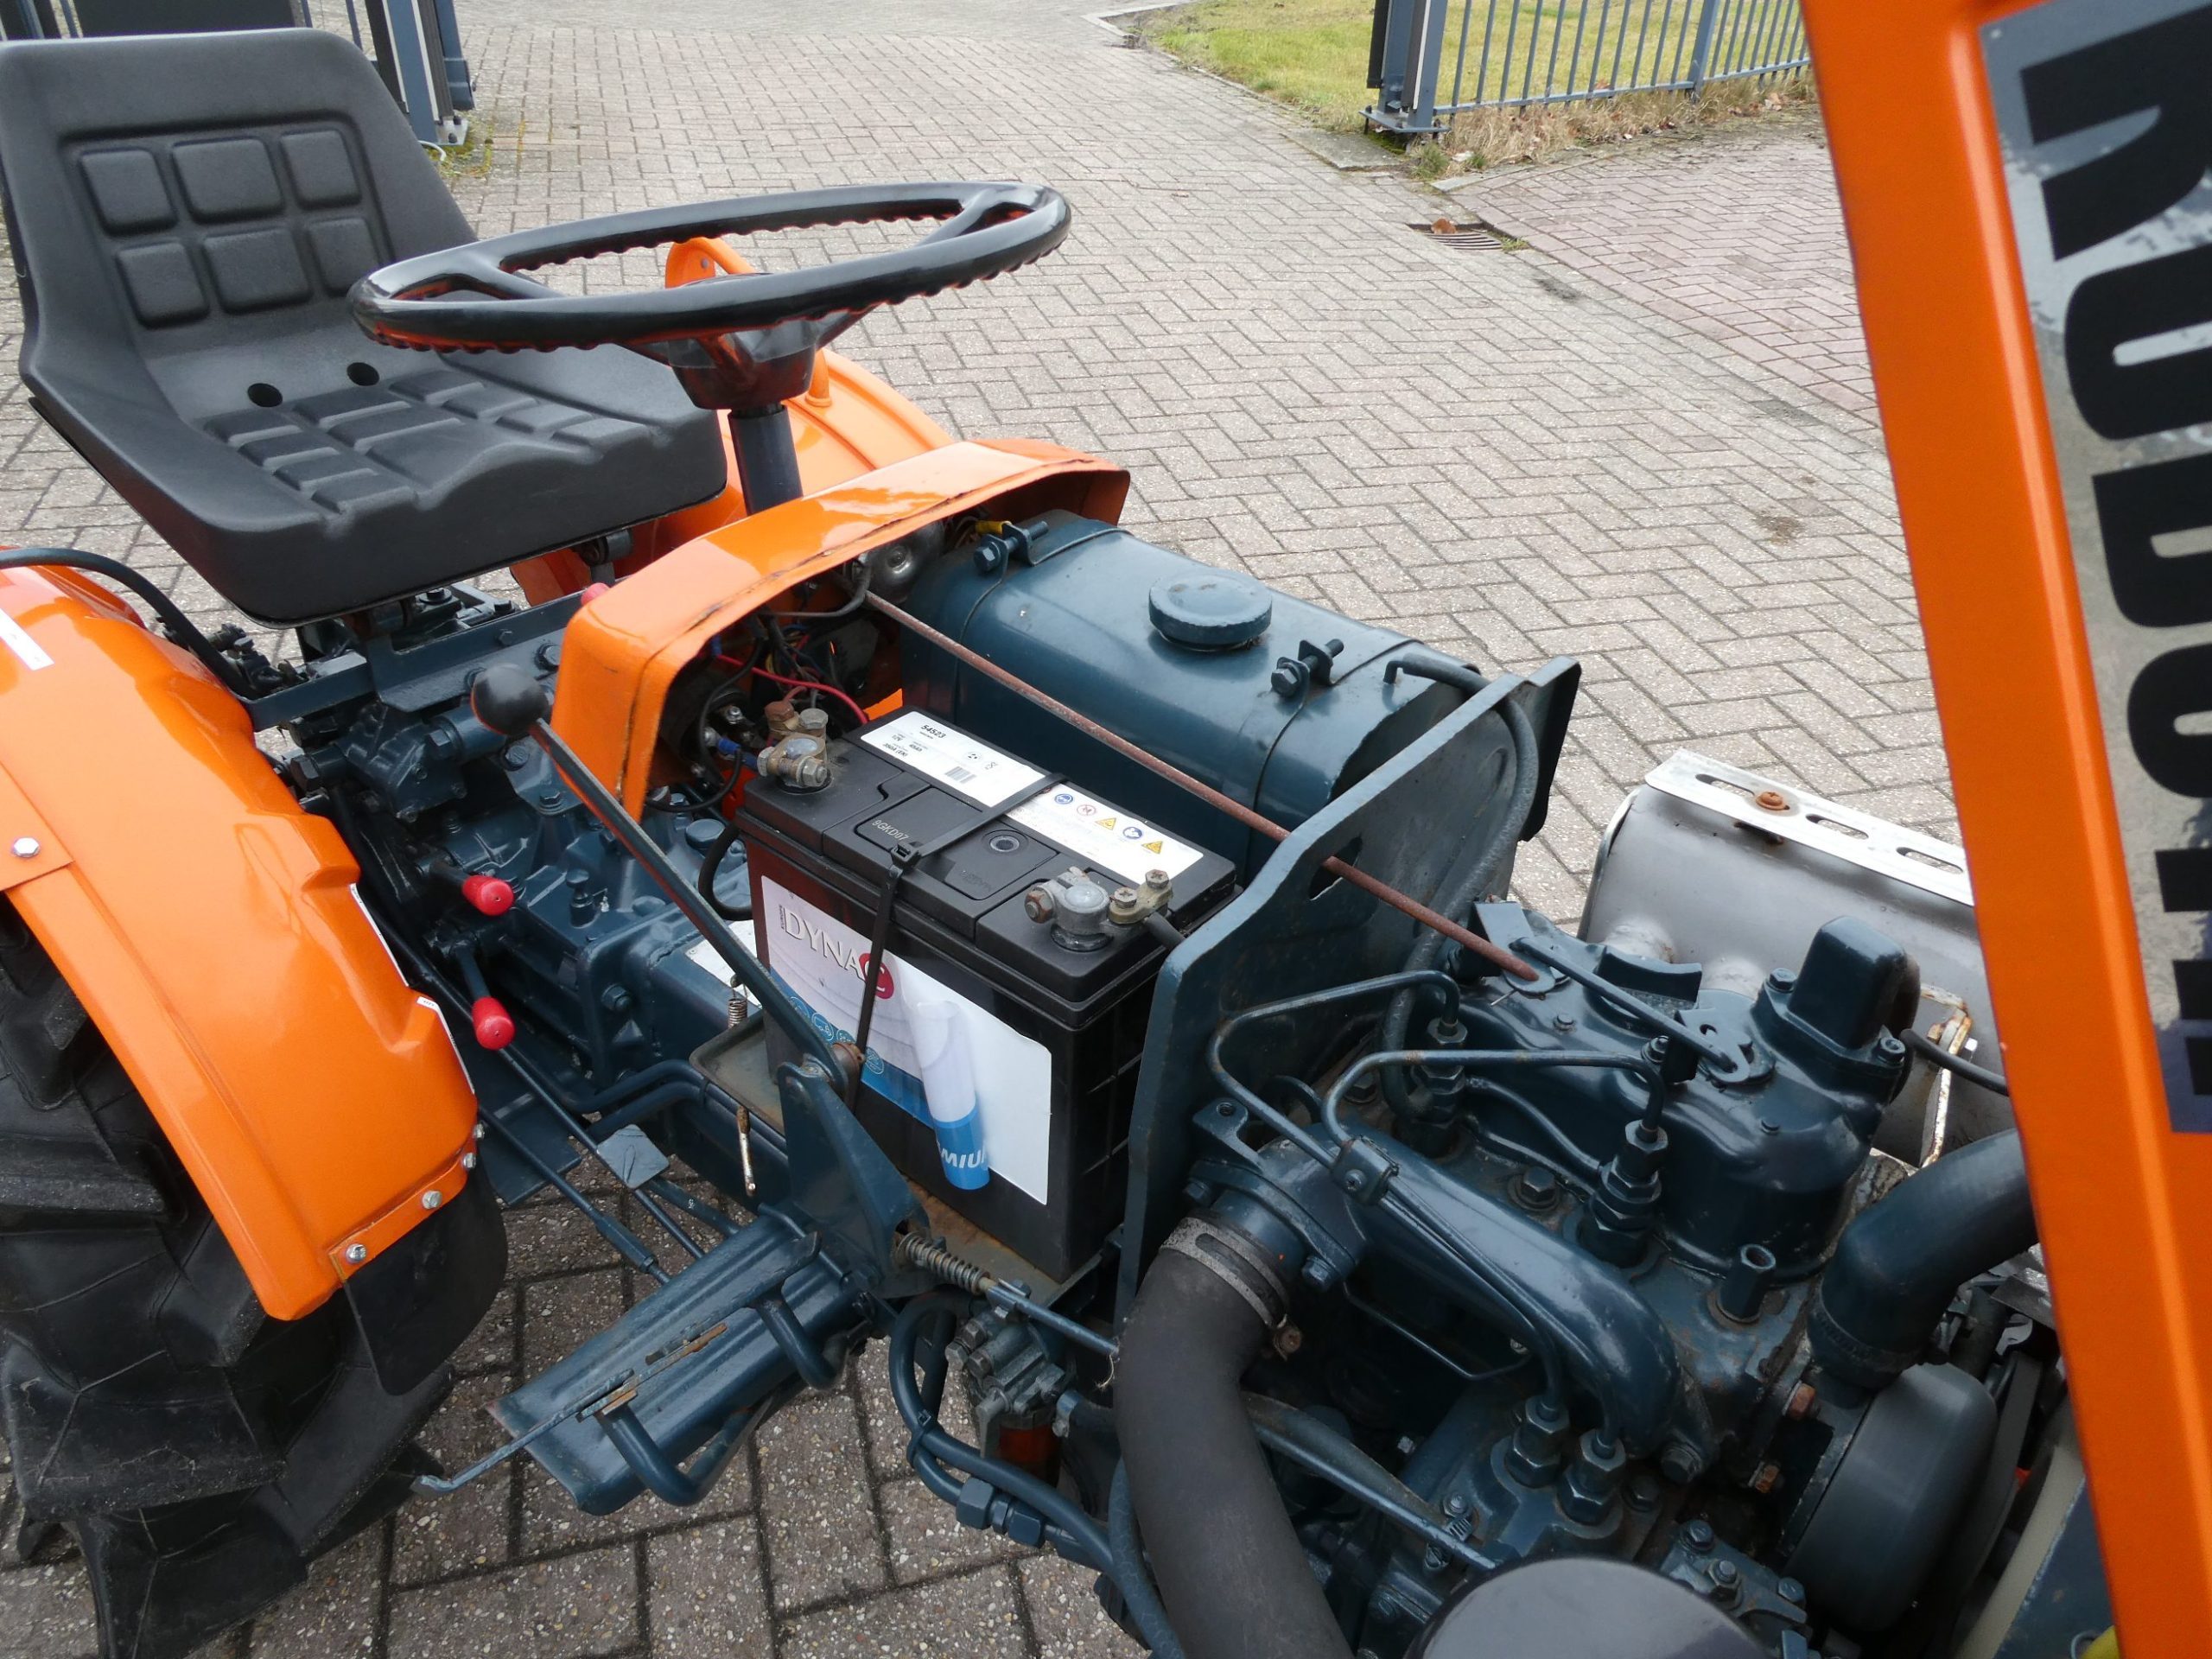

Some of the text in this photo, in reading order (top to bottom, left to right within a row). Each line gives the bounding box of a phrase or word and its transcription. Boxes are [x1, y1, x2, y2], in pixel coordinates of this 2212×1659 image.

[920, 724, 947, 739] 54523
[872, 819, 909, 841] 9GKD07
[936, 1140, 987, 1169] MIU
